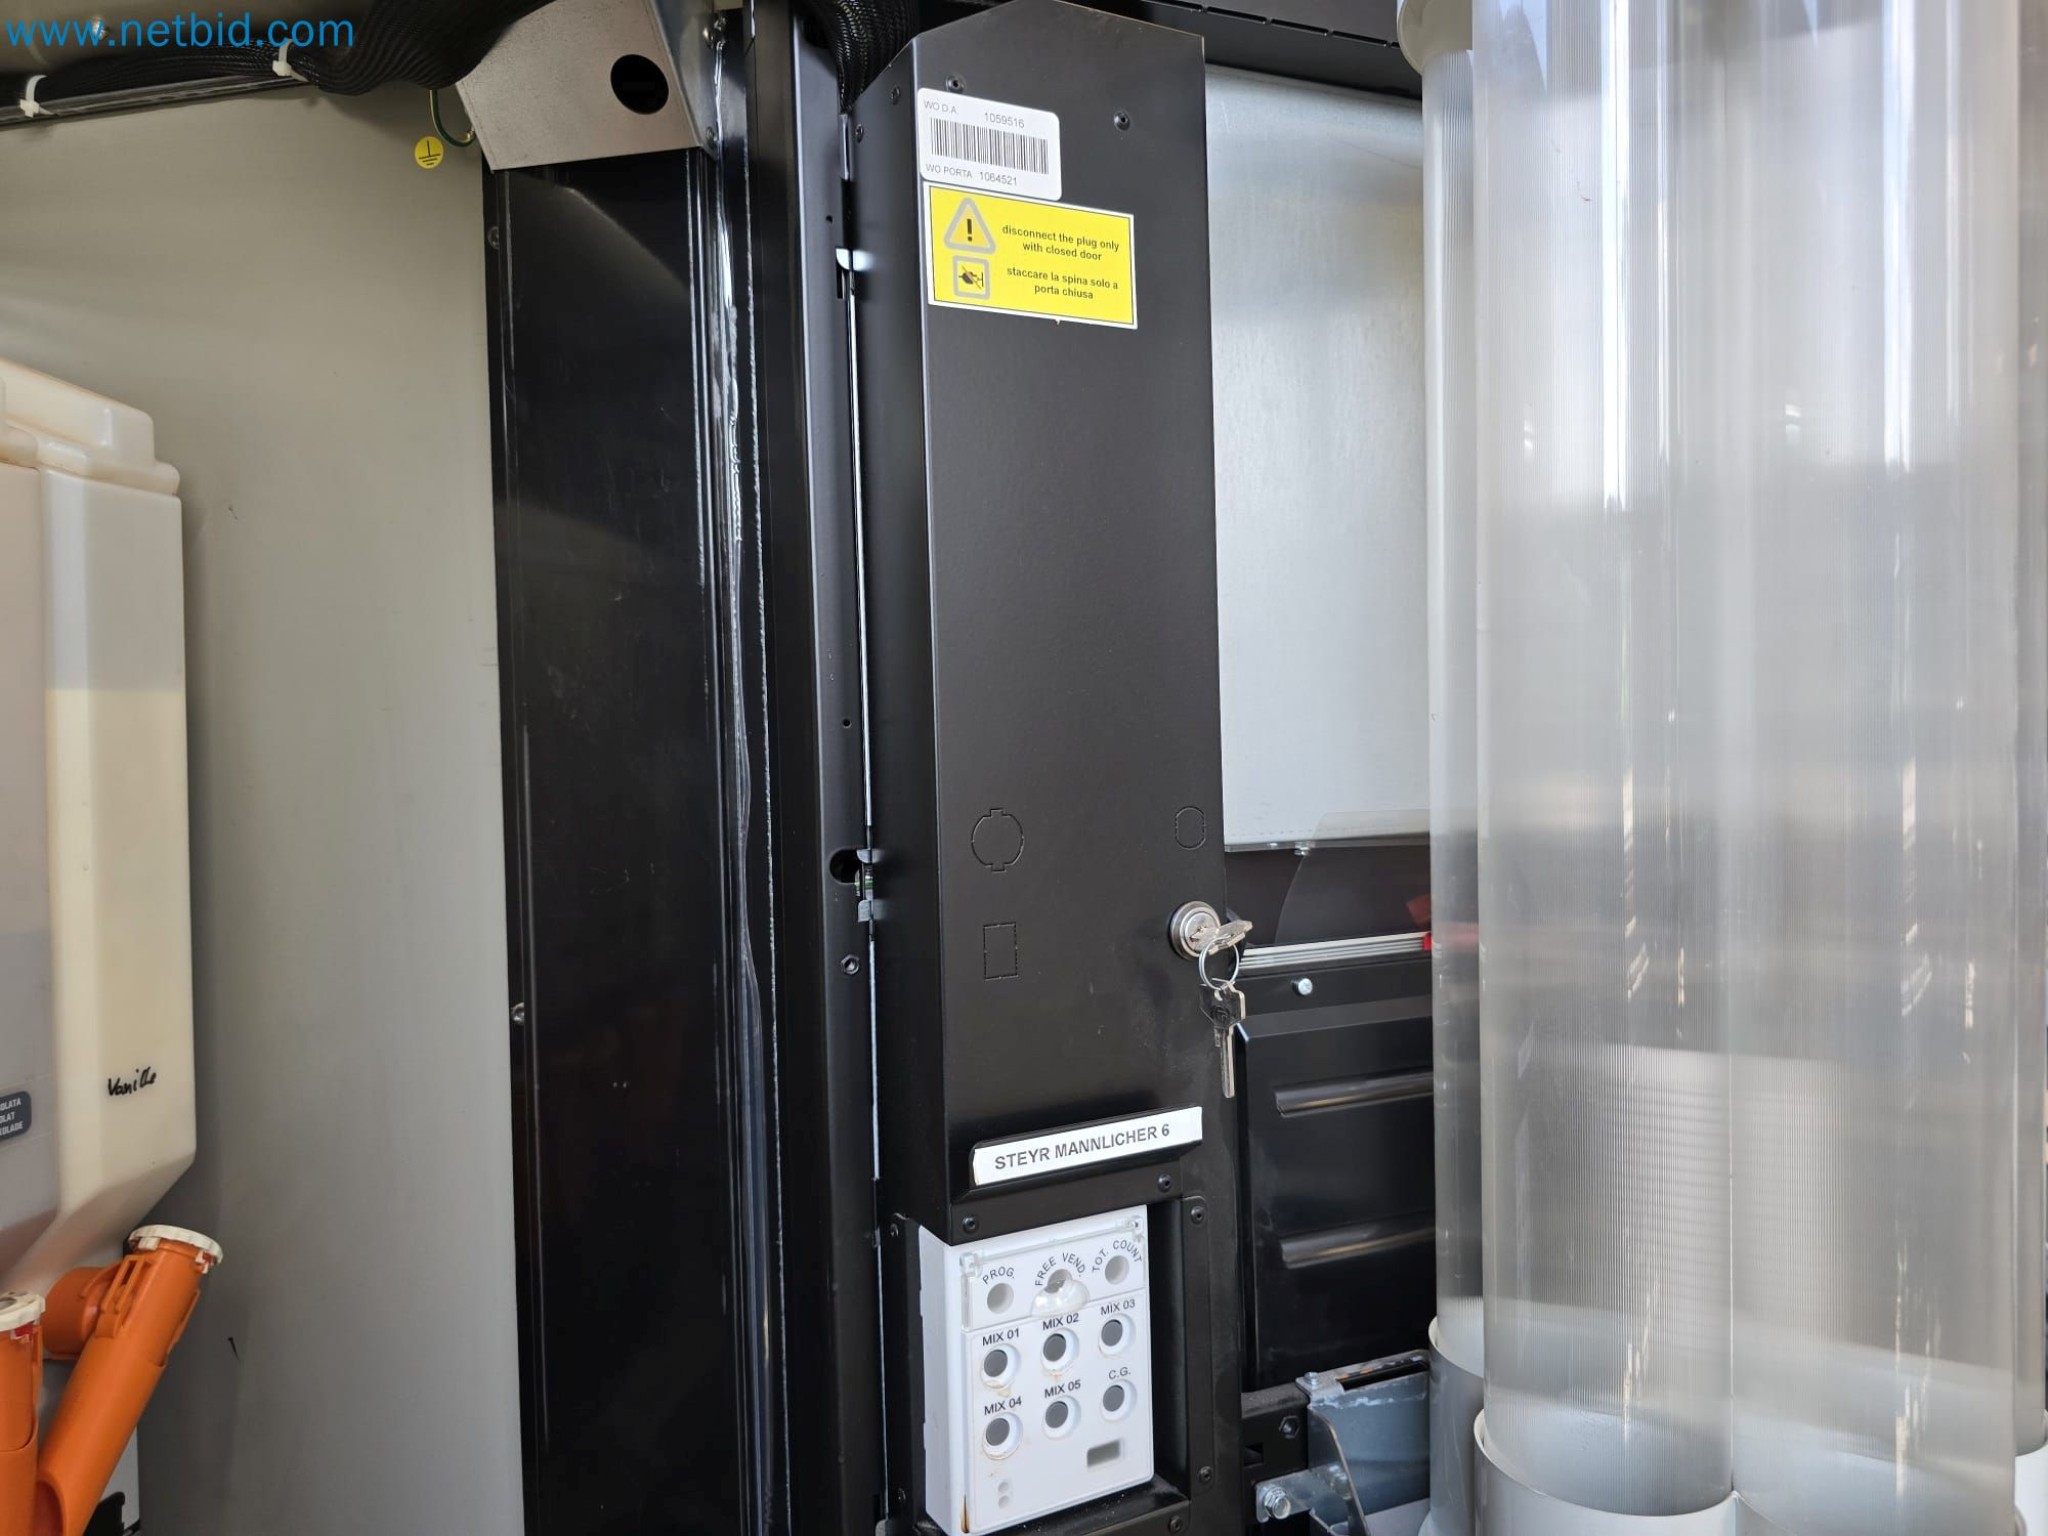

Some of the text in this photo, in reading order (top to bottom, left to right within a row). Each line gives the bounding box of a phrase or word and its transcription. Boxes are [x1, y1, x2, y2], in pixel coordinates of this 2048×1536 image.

[984, 112, 1025, 128] 1059516
[926, 163, 1017, 186] WO PORTA 1064521
[1002, 225, 1120, 253] disconnect the plug only
[1022, 241, 1102, 261] with closed door
[1006, 267, 1118, 290] staccare la spina solo a
[1034, 283, 1094, 300] porta chiusa
[994, 1123, 1170, 1170] STEYR MANNLICHER 6
[1091, 1239, 1143, 1273] TOT. COUNT
[982, 1265, 1015, 1286] PROG.
[1034, 1256, 1057, 1287] FREE
[1100, 1299, 1136, 1315] MIX 03
[1042, 1313, 1080, 1331] MIX 02
[982, 1329, 1020, 1347] MIX 01
[1108, 1367, 1131, 1382] C.G.
[1044, 1380, 1081, 1398] MIX 05
[984, 1397, 1022, 1416] MIX 04
